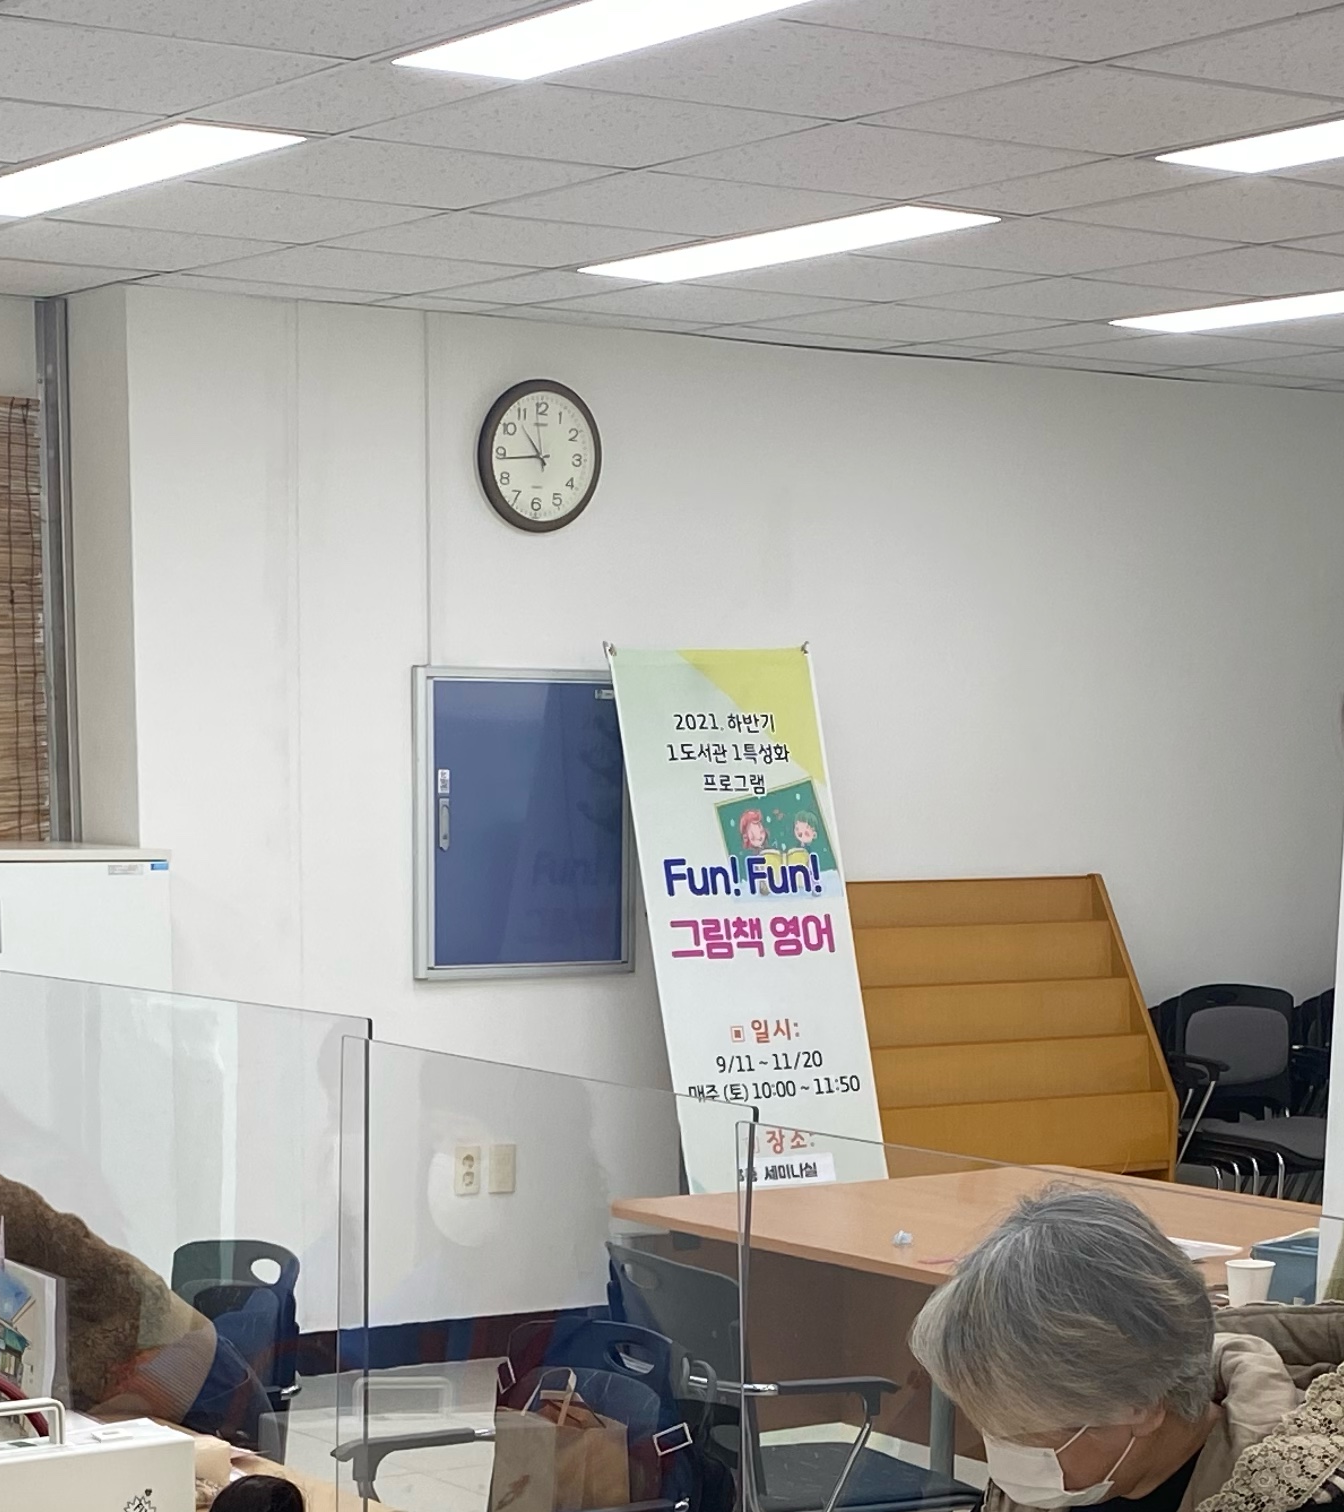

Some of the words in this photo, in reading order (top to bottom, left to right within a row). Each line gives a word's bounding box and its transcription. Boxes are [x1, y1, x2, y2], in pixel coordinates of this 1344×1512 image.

[517, 407, 527, 421] 11
[536, 402, 549, 416] 12
[502, 422, 517, 436] 10
[568, 428, 579, 442] 2
[495, 446, 507, 460] 9
[571, 453, 582, 467] 3
[499, 471, 510, 485] 8
[565, 477, 575, 490] 4
[511, 489, 522, 503] 7
[552, 493, 562, 507] 5
[531, 497, 542, 511] 6
[673, 713, 725, 730] 2021.
[727, 713, 775, 733] 하반기
[667, 743, 727, 764] 1도서관
[732, 743, 790, 765] 1특성화
[703, 774, 766, 795] 프로그램
[663, 856, 741, 897] Fun!
[746, 854, 822, 895] Fun!
[670, 916, 765, 959] 그림책
[770, 913, 836, 957] 영어
[751, 1018, 800, 1044] 일시:
[716, 1054, 755, 1073] 9/11
[772, 1050, 823, 1071] 11/20
[688, 1084, 720, 1103] 매주
[723, 1083, 749, 1102] (토)
[752, 1080, 796, 1100] 10:00
[813, 1075, 861, 1096] 11:50
[764, 1162, 818, 1181] 세미나실
